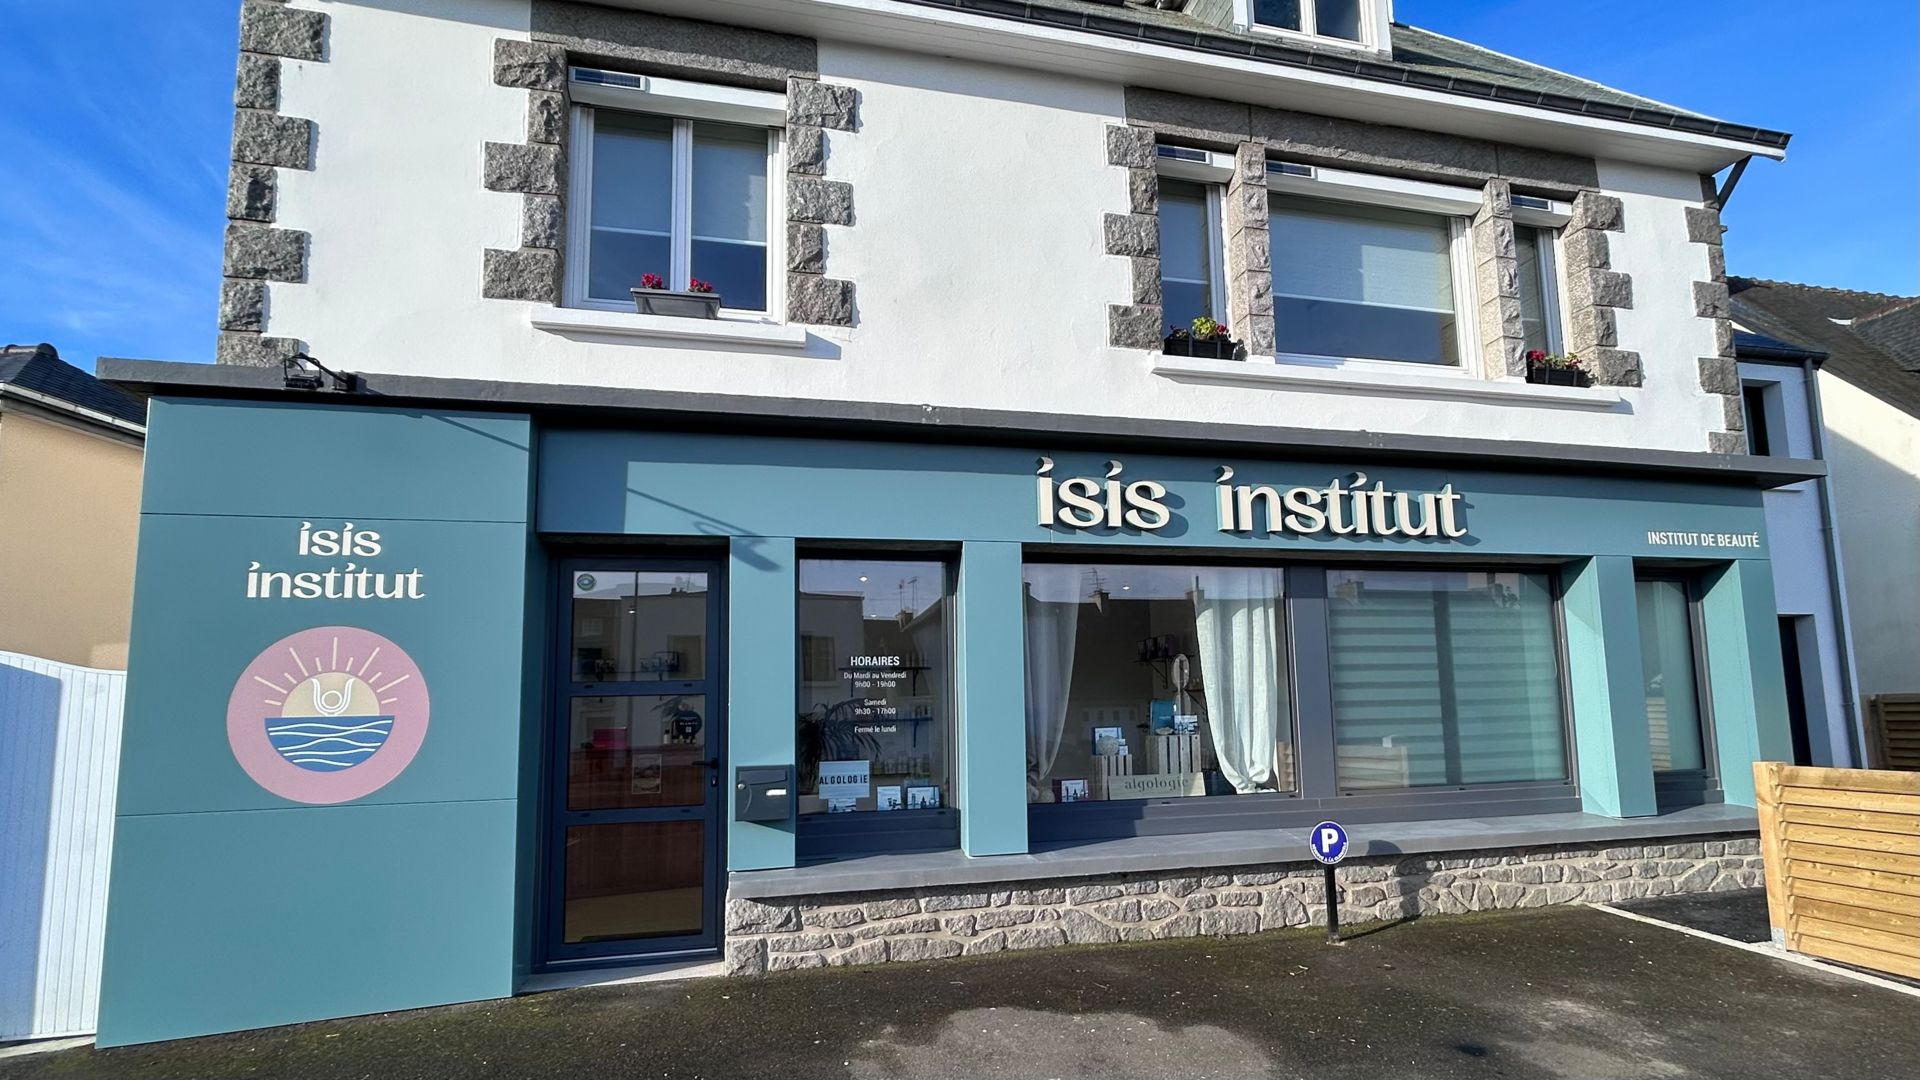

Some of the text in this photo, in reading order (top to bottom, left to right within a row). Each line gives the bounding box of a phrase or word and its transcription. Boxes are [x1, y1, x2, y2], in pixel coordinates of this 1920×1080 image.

[1036, 456, 1468, 538] isis institut
[1647, 531, 1760, 548] INSTITUT DE BEAUTÉ
[247, 521, 425, 599] isis institut
[850, 656, 900, 666] HORAIRES
[864, 698, 887, 706] Samedi
[877, 707, 896, 715] 17h00
[854, 725, 873, 733] Fermé
[874, 725, 881, 733] le
[1124, 776, 1189, 792] algologie
[1321, 828, 1339, 853] P
